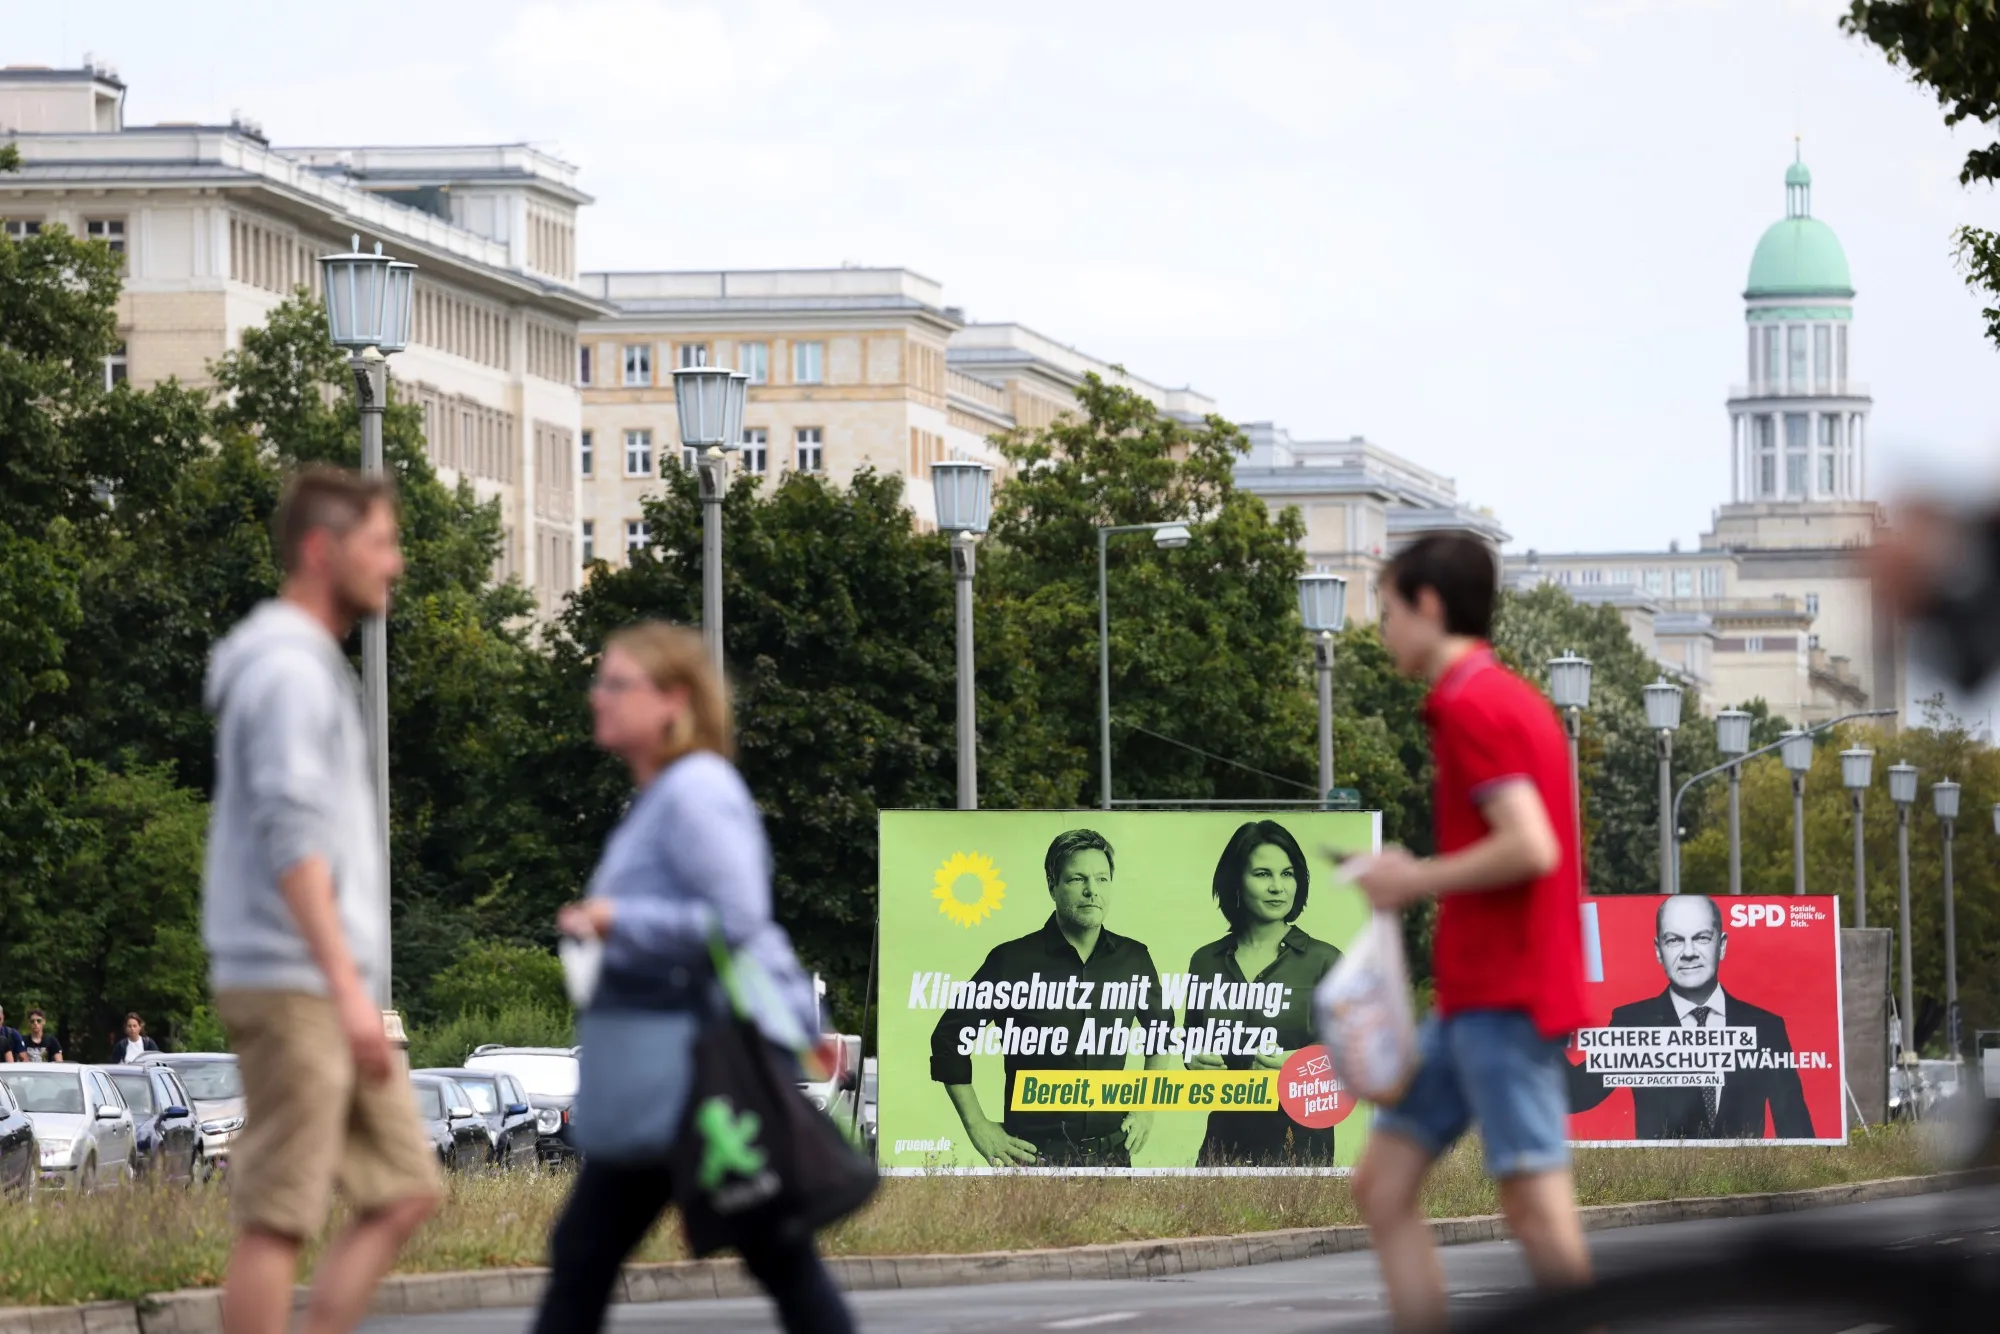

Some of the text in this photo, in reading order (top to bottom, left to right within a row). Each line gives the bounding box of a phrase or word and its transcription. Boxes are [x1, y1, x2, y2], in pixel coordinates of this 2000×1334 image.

[1730, 904, 1786, 928] SPD
[1790, 904, 1816, 913] Soziale
[1790, 912, 1826, 920] Politik für
[1790, 920, 1810, 928] Dich.
[908, 971, 1292, 1018] Klimaschutz mit Wirkung:
[957, 1017, 1284, 1064] sichere Arbeitsplätze.
[1580, 1030, 1754, 1047] SICHERE ARBEIT &
[1589, 1047, 1833, 1069] KLIMASCHUTZ WÄHLEN.
[1604, 1075, 1723, 1085] SCHOLZ PACKT DAS AN.
[1021, 1076, 1273, 1108] Bereit, weil Ihr es seid.
[1304, 1092, 1339, 1118] jetzt!
[894, 1136, 951, 1155] gruene.de
